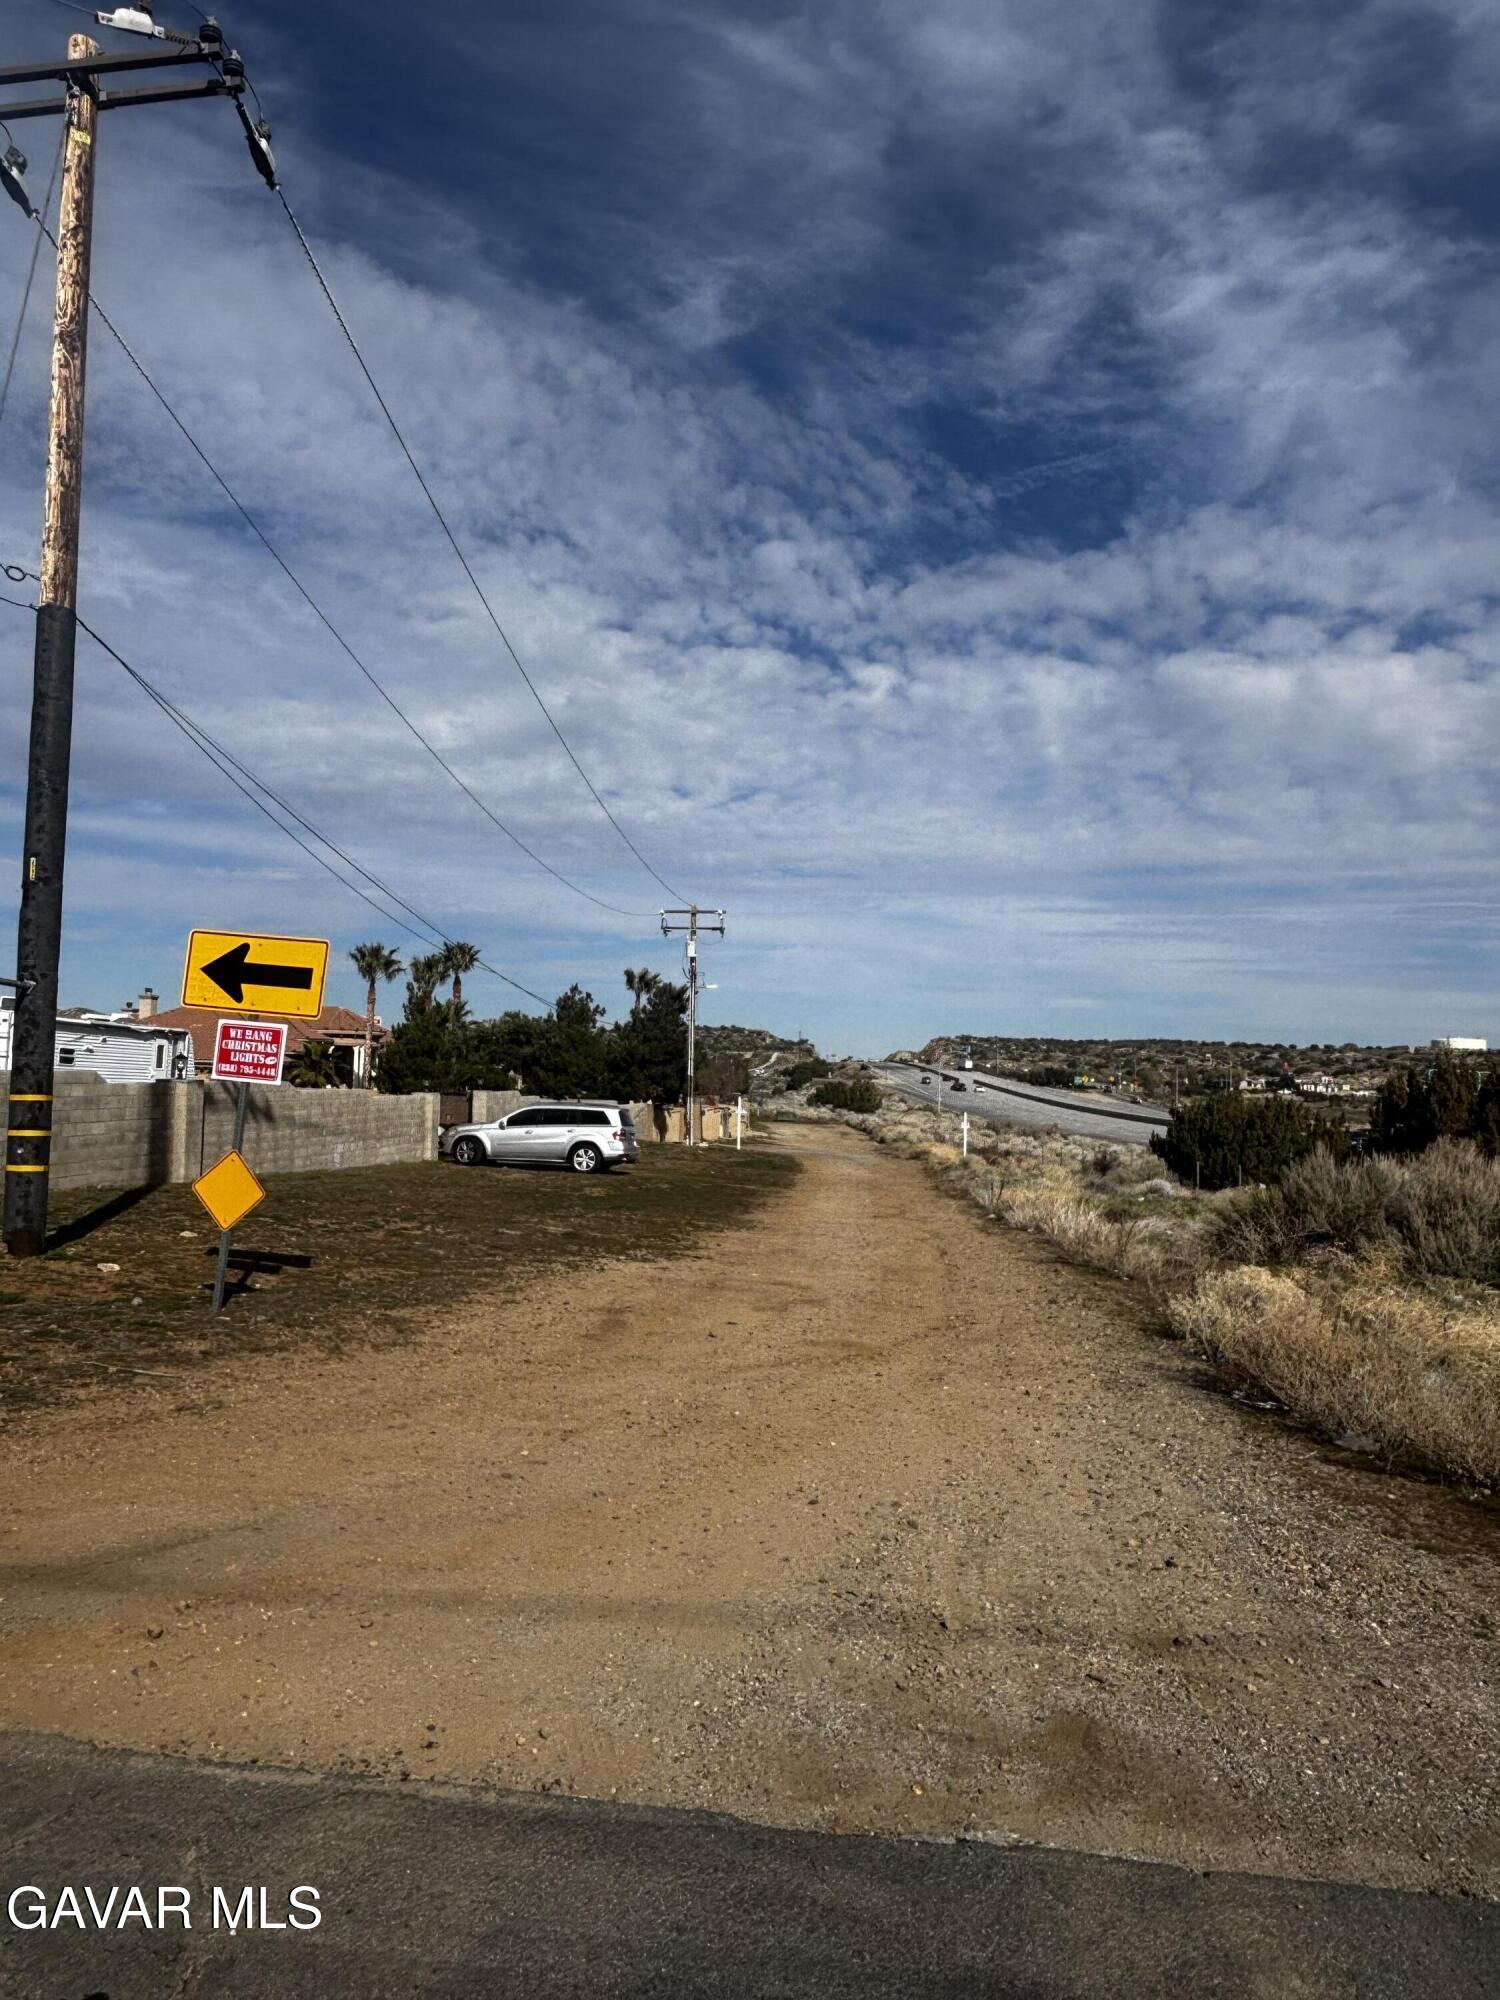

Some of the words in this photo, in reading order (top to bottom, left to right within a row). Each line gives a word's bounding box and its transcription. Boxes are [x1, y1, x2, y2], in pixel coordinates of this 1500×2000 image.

[230, 1028, 243, 1039] WE
[245, 1029, 273, 1042] HANG
[221, 1039, 278, 1054] CHRISTMAS
[230, 1051, 265, 1064] LIGHTS
